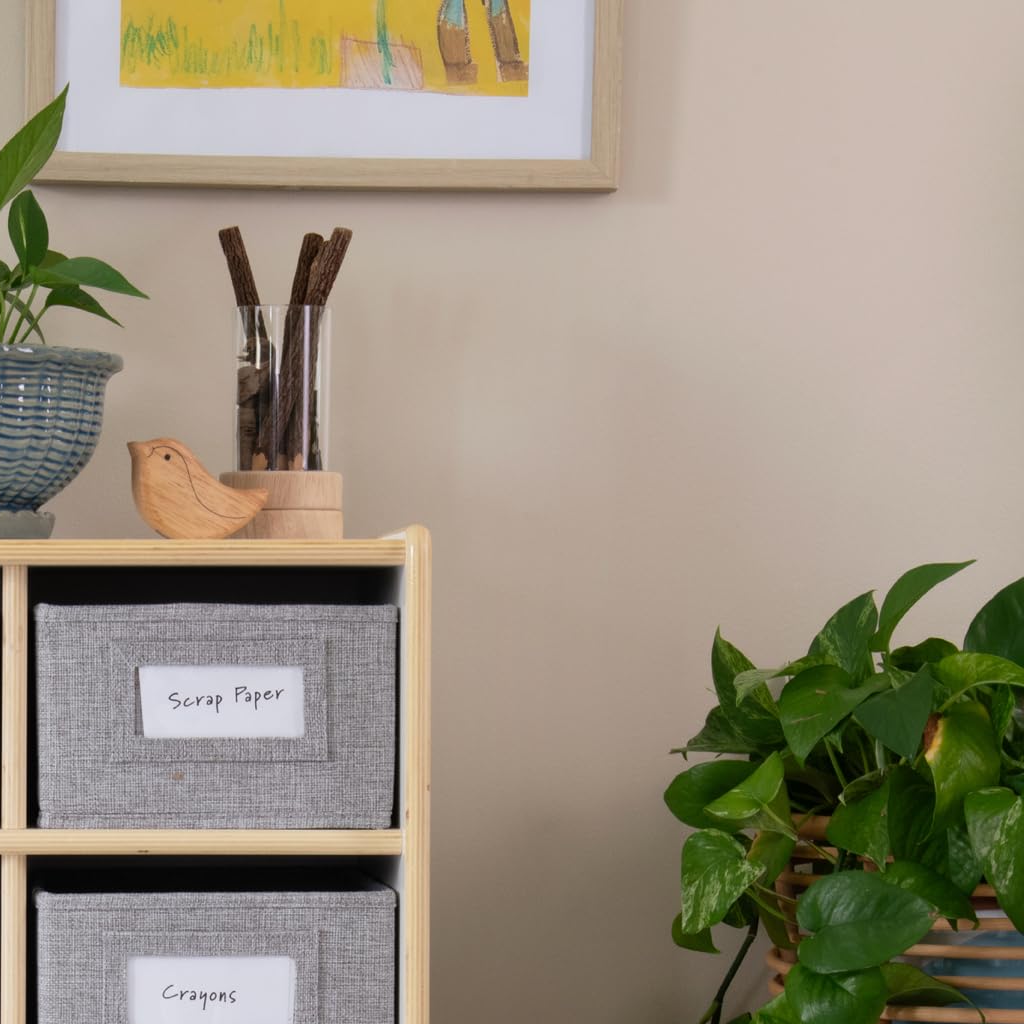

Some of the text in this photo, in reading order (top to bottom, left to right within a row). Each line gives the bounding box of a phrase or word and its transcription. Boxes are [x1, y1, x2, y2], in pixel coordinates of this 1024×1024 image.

[166, 685, 286, 714] Scrap Paper
[161, 984, 238, 1011] Crayons
